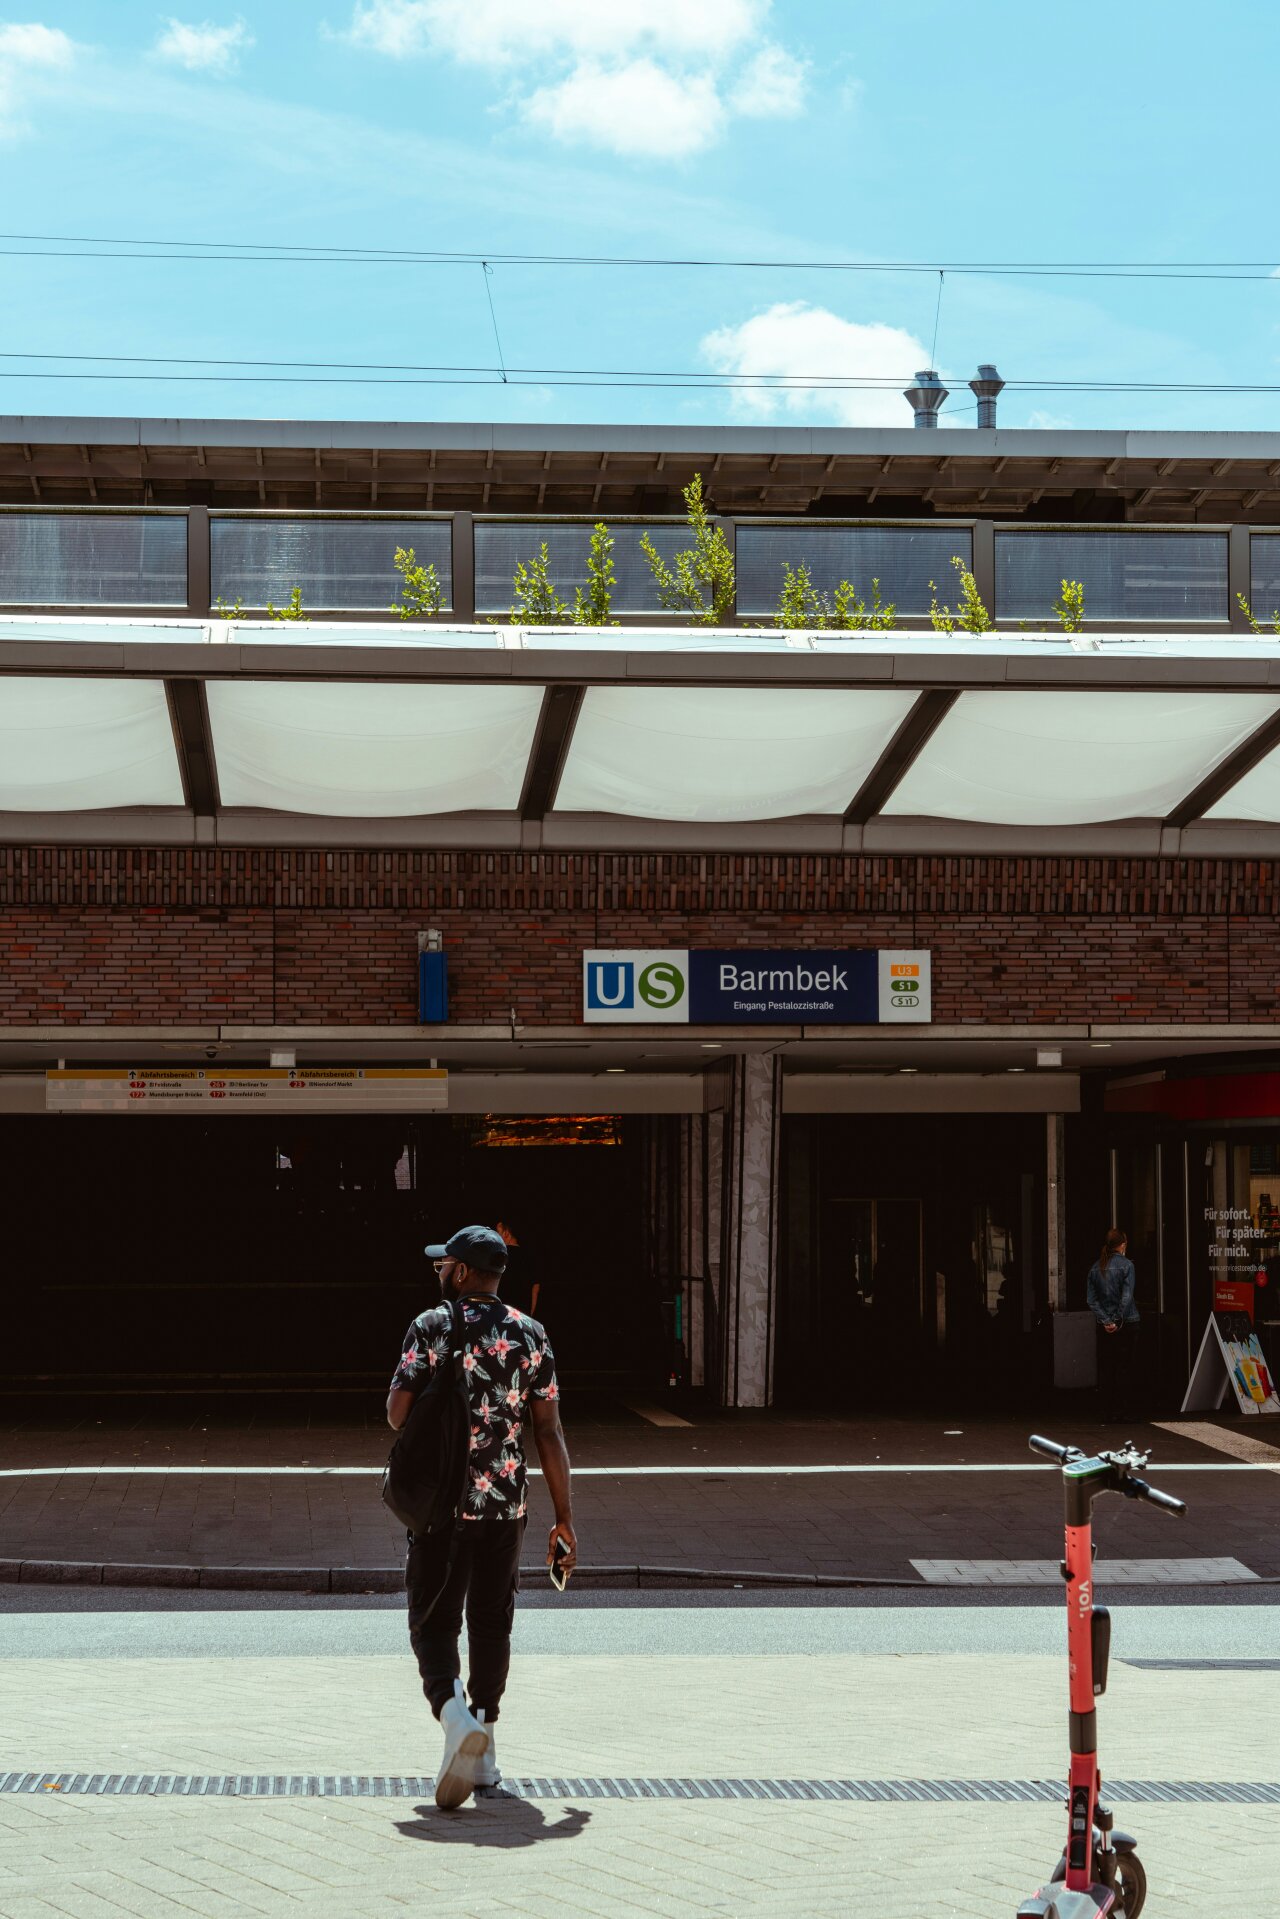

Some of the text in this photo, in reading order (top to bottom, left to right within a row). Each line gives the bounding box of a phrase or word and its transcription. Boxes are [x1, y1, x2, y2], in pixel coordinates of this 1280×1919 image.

[897, 966, 912, 975] U3
[719, 964, 848, 991] Barmbek
[596, 966, 675, 1006] U S
[733, 1001, 834, 1011] Eingang Pestalozzistraße
[1204, 1208, 1251, 1220] Für sofort.
[1216, 1225, 1267, 1241] Für später.
[1208, 1244, 1250, 1257] Für mich.
